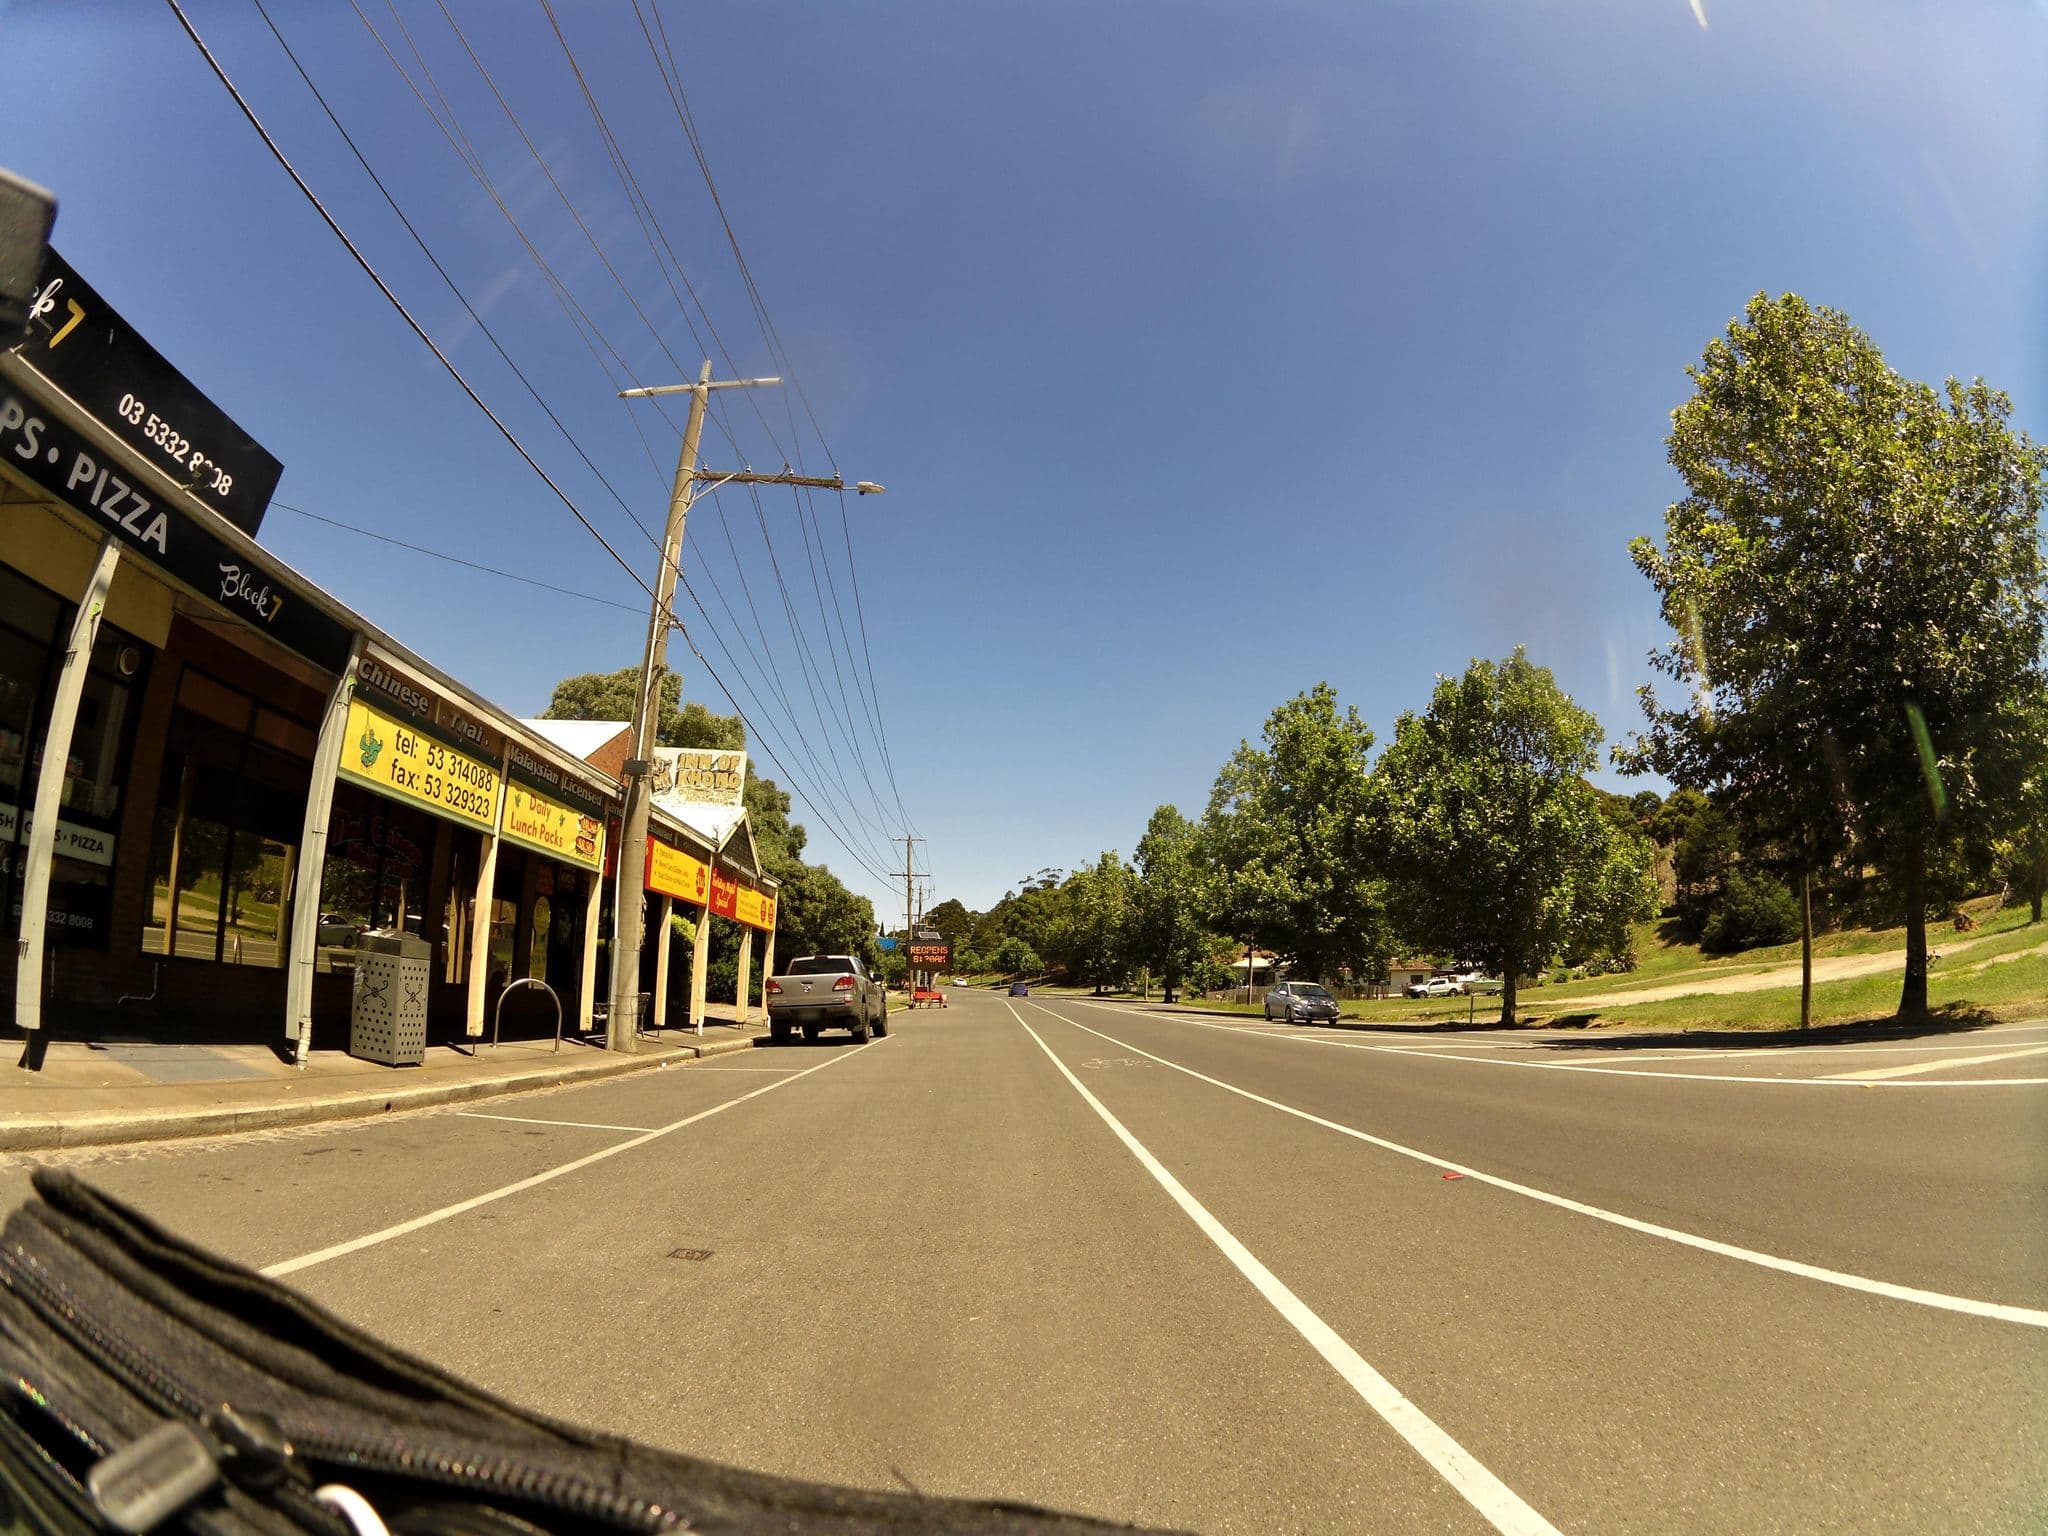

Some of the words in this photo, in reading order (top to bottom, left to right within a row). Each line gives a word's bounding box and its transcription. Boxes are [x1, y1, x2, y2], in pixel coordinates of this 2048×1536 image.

[49, 298, 86, 349] 7
[119, 393, 145, 425] 03
[144, 413, 190, 464] 5332
[189, 451, 233, 496] 808
[67, 452, 167, 554] PIZZA
[219, 562, 269, 617] Block
[268, 594, 283, 622] 7
[358, 658, 429, 714] Chinese
[510, 744, 559, 786] Malaysian
[562, 774, 603, 807] Licensed
[391, 758, 420, 791] fax:
[424, 773, 442, 799] 53
[445, 782, 490, 818] 329323
[396, 729, 419, 759] tel:
[426, 743, 445, 770] 53
[448, 754, 493, 792] 314088
[717, 754, 741, 771] OF
[510, 811, 538, 839] Lunch
[539, 823, 564, 848] Packs
[529, 792, 552, 823] Daily
[70, 833, 105, 853] PIZZA
[910, 945, 949, 954] REOPENS
